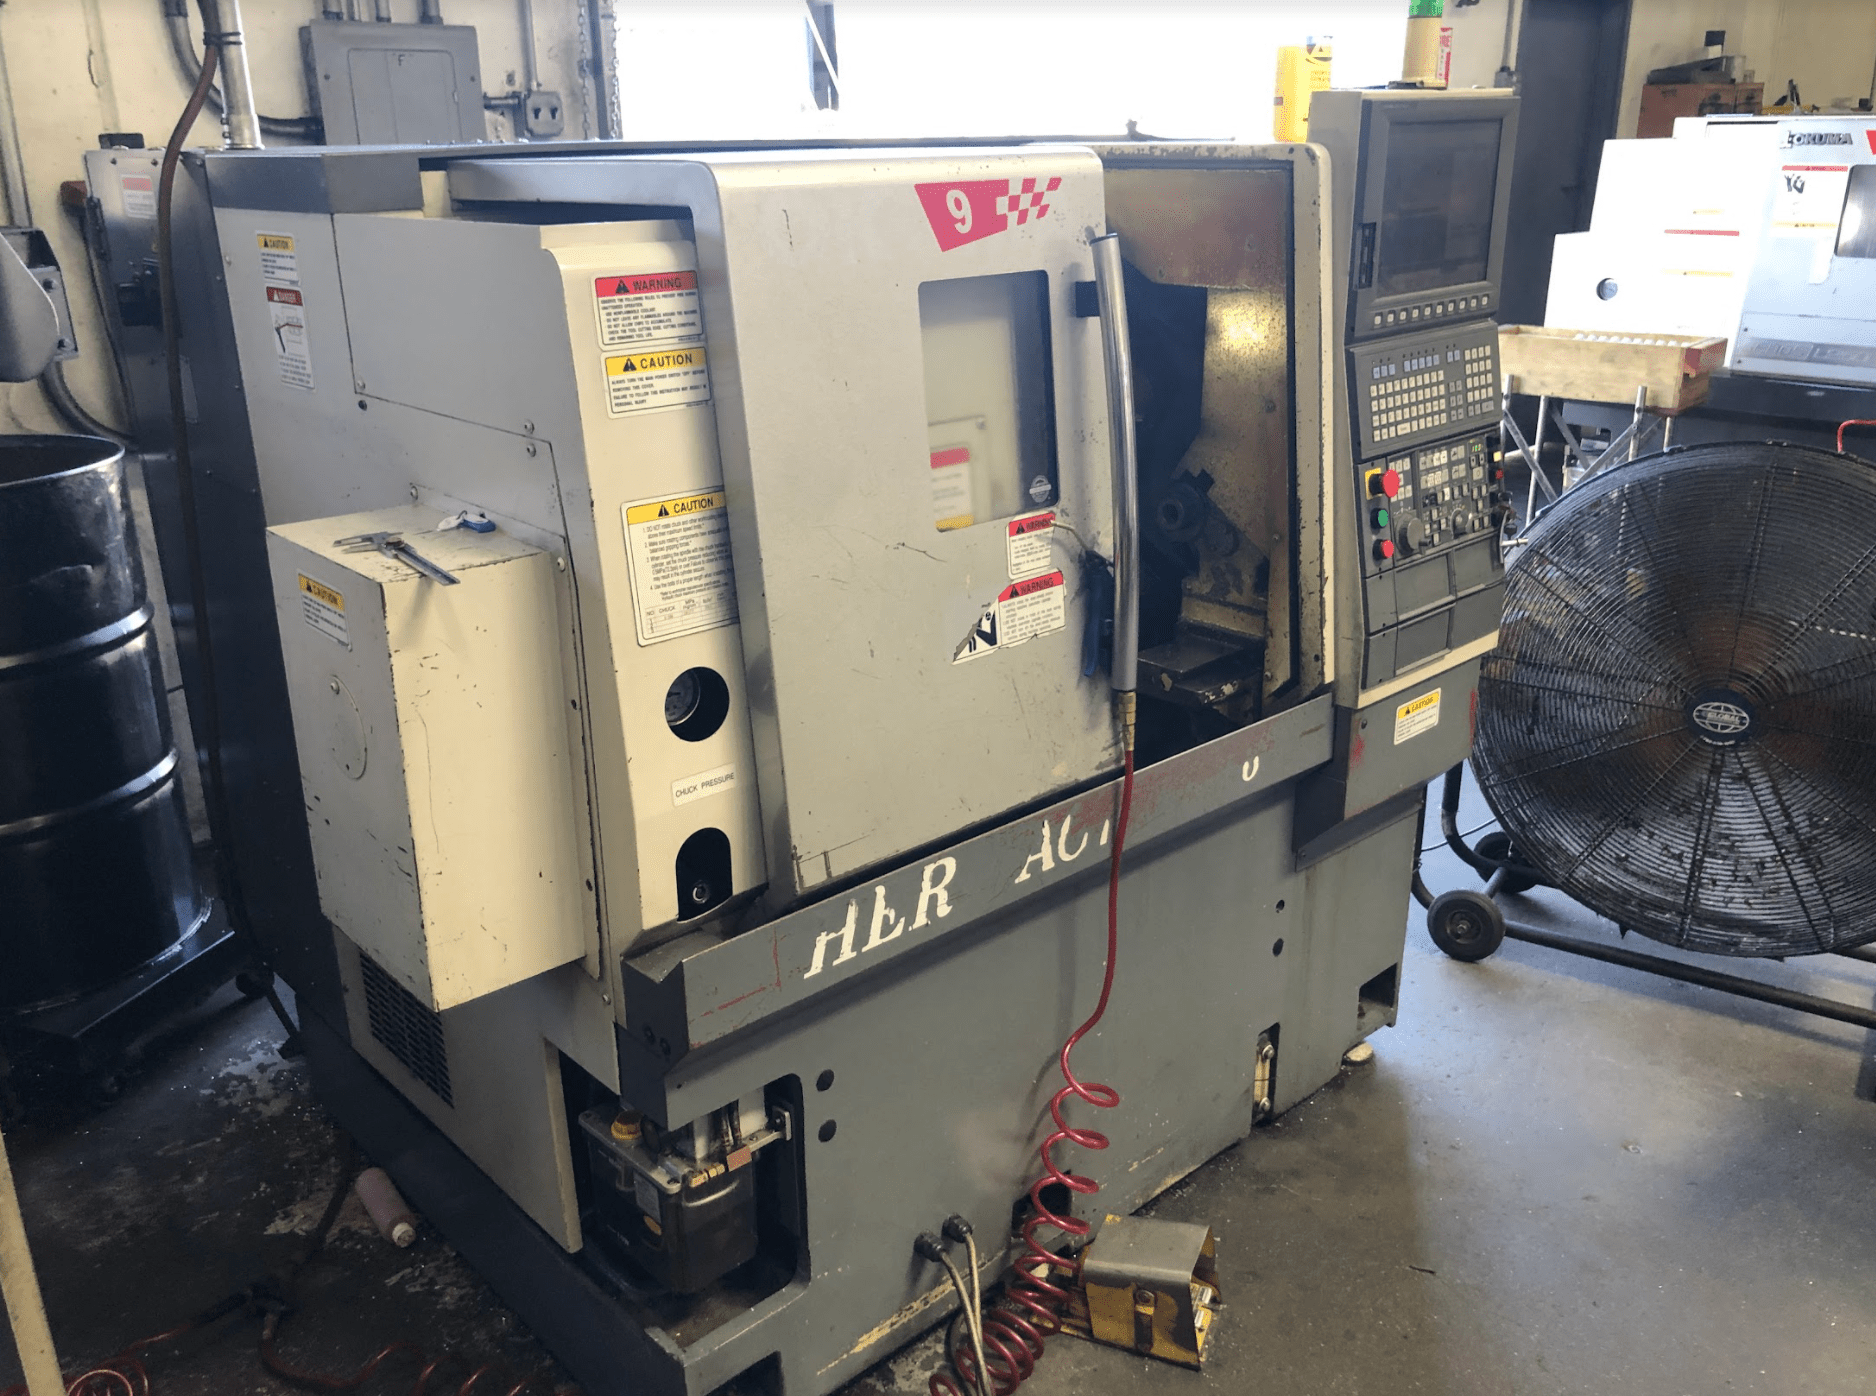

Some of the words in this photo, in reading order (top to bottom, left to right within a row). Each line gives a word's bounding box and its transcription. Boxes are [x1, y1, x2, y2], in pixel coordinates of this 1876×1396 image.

[1793, 132, 1853, 146] OKUMA
[945, 189, 973, 234] 9
[633, 278, 682, 291] WARNING
[640, 353, 692, 369] CAUTION
[673, 497, 714, 514] CAUTION
[1020, 577, 1054, 594] WARNING
[313, 583, 338, 605] CAUTION
[1411, 696, 1434, 712] CAUTION
[1708, 712, 1740, 722] GLOBAL
[675, 784, 698, 798] CHUCK
[700, 772, 735, 789] PRESSURE
